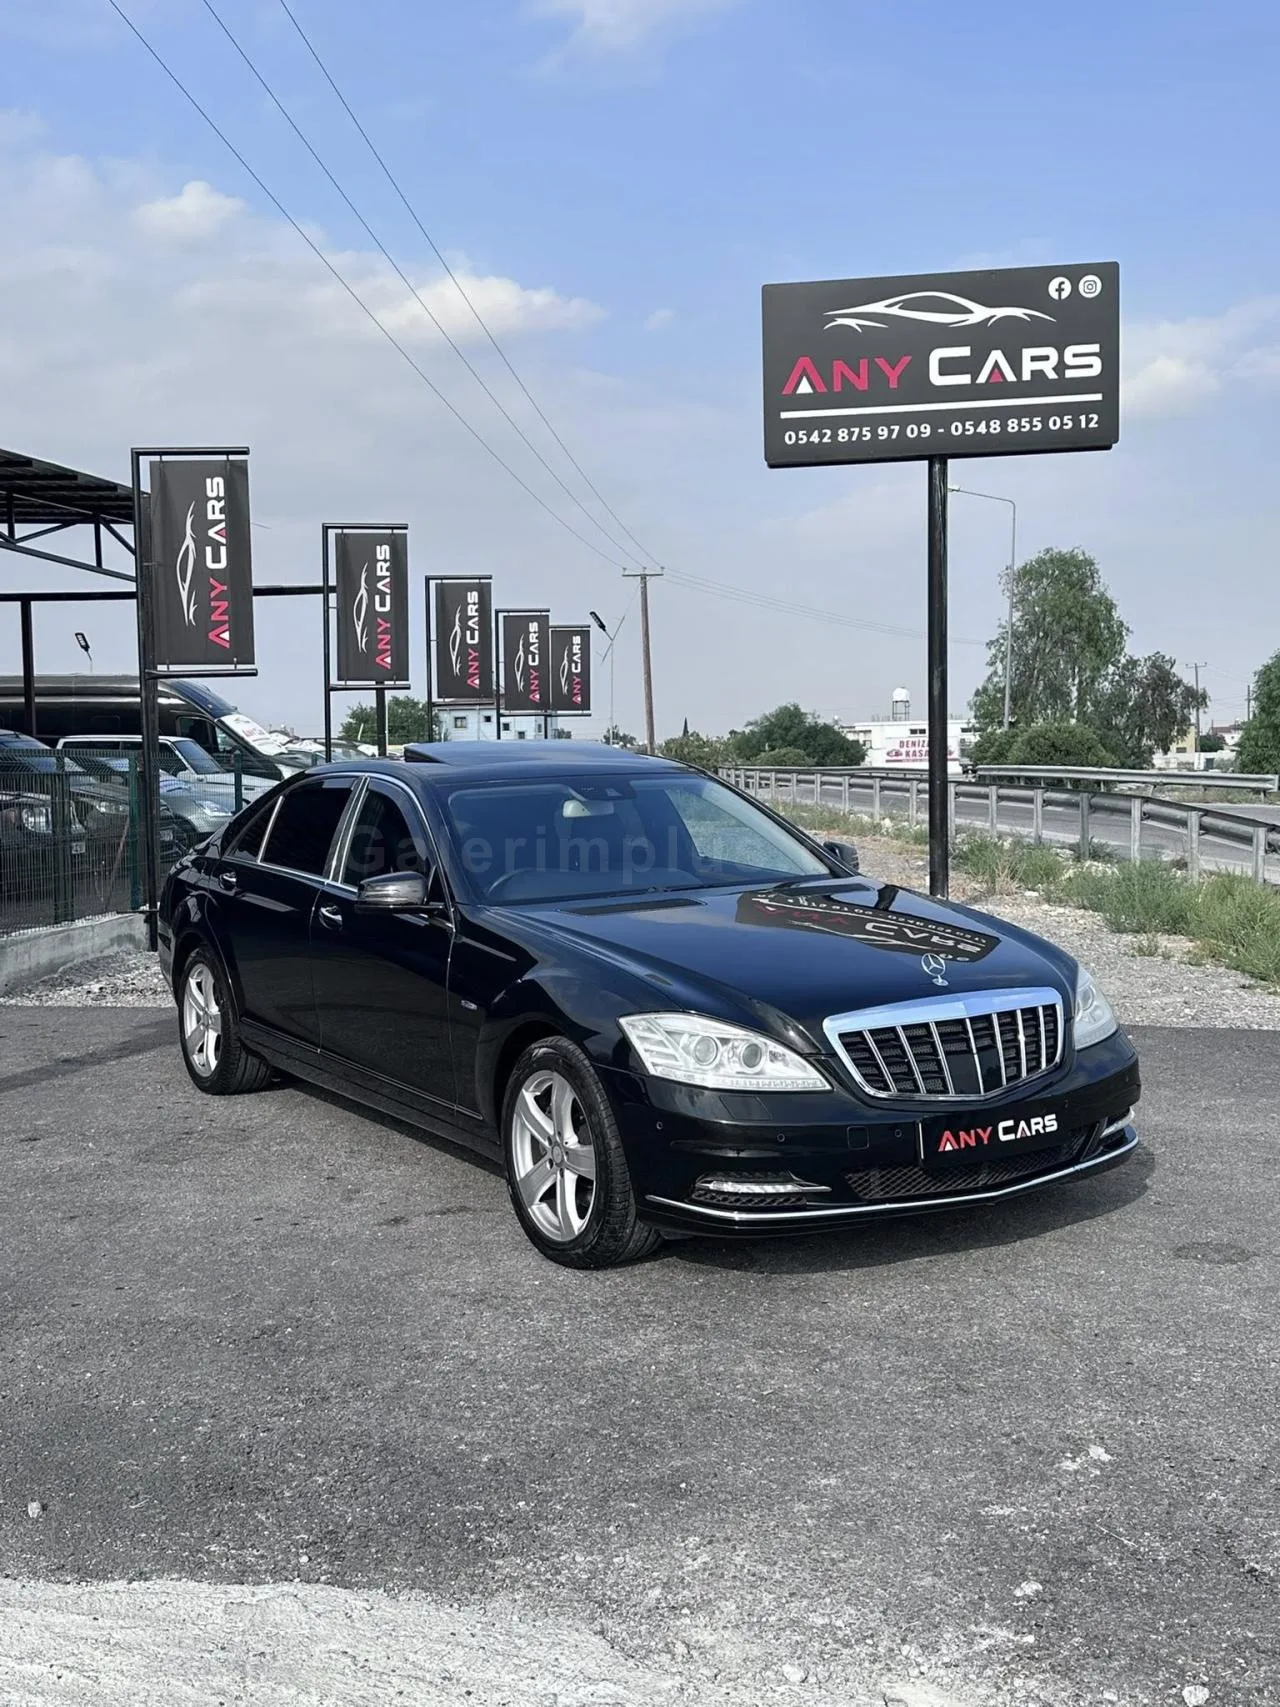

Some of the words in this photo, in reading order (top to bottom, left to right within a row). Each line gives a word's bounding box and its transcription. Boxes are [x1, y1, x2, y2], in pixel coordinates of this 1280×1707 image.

[781, 355, 912, 395] ANY
[928, 343, 1102, 386] CARS
[784, 428, 832, 446] 0542
[837, 426, 871, 442] 875
[878, 425, 900, 440] 97
[906, 423, 931, 439] 09
[950, 419, 1001, 437] 0548
[1007, 417, 1042, 432] 855
[1048, 415, 1073, 431] 05
[1079, 414, 1099, 429] 12
[205, 476, 227, 570] CARS
[374, 544, 391, 612] CARS
[208, 577, 230, 649] ANY
[466, 590, 479, 645] CARS
[375, 617, 392, 670] ANY
[528, 621, 539, 666] CARS
[571, 635, 581, 673] CARS
[466, 648, 480, 689] ANY
[528, 669, 540, 703] ANY
[571, 675, 582, 704] ANY
[938, 1126, 993, 1152] ANY
[998, 1113, 1058, 1141] CARS
